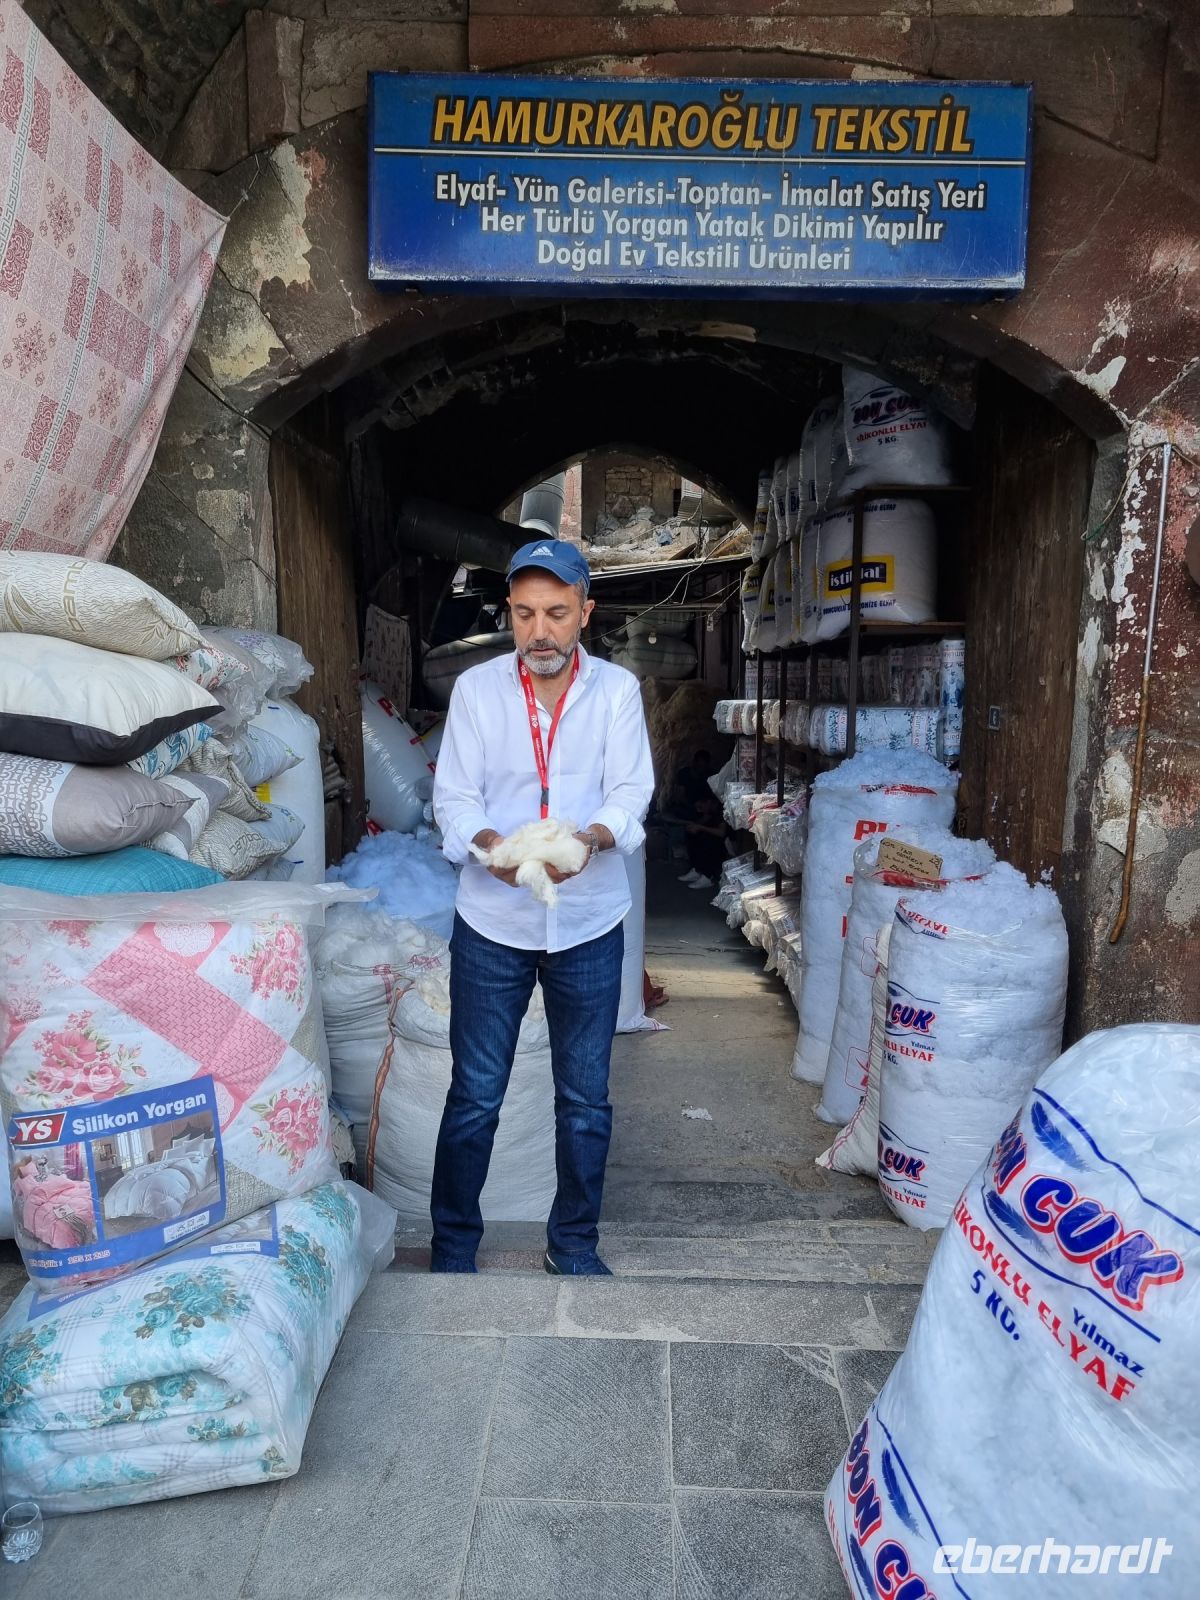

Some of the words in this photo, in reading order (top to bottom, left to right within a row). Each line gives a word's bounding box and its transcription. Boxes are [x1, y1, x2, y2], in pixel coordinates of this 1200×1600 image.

[433, 92, 798, 151] HAMURKAROĞLU
[813, 95, 974, 153] TEKSTİL
[436, 174, 506, 205] Elyaf-
[514, 175, 559, 203] Yün
[782, 172, 863, 208] İmalat
[870, 180, 931, 214] Satış
[938, 182, 985, 208] Yeri
[481, 209, 526, 231] Her
[533, 208, 595, 234] Türlü
[603, 211, 688, 240] Yorgan
[696, 212, 765, 237] Yatak
[774, 213, 854, 239] Dikimi
[862, 215, 944, 244] Yapılır
[537, 240, 610, 270] Doğal
[619, 242, 646, 266] Ev
[653, 242, 740, 268] Tekstili
[749, 237, 852, 270] Ürünleri
[900, 1045, 935, 1063] ELYAF
[18, 1118, 53, 1142] YS
[72, 1110, 139, 1136] Silikon
[143, 1093, 207, 1120] Yorgan
[894, 1190, 926, 1209] ELYAF
[1020, 1174, 1184, 1311] CUK
[970, 1269, 986, 1294] 5
[1038, 1299, 1136, 1402] ELYAF
[1072, 1308, 1146, 1377] Yılmaz
